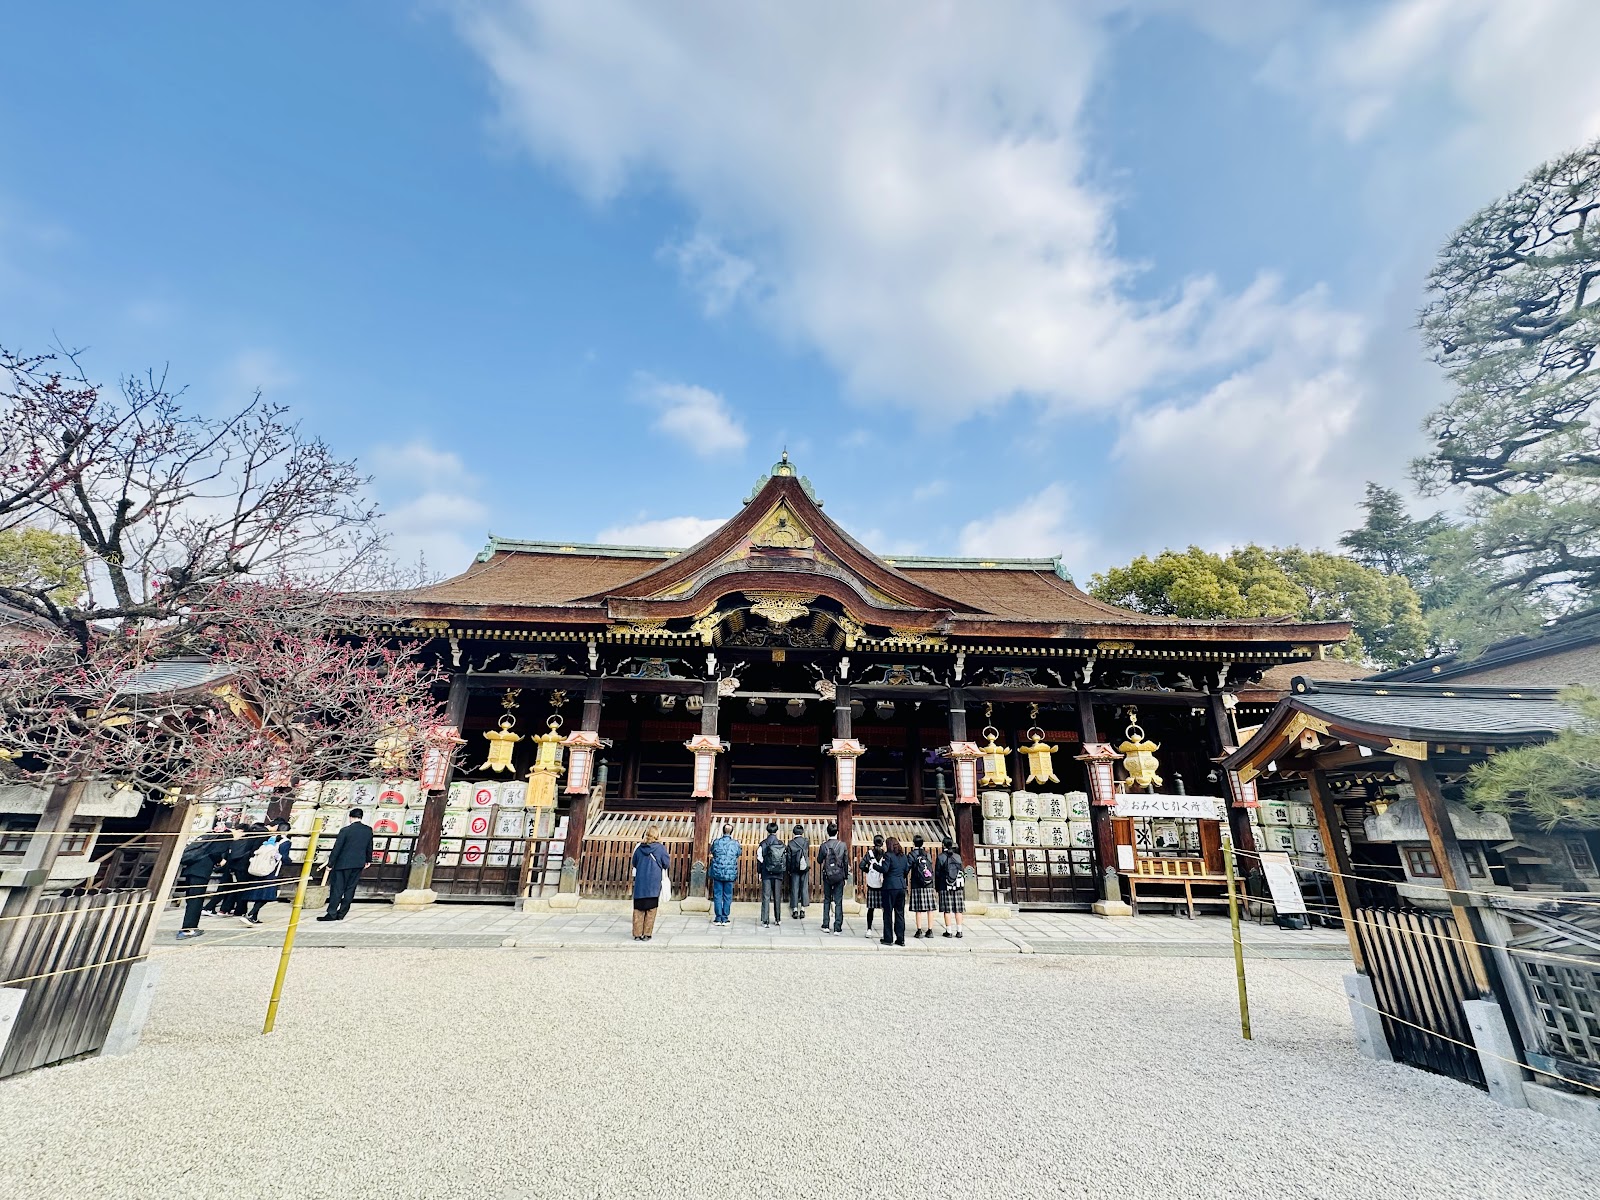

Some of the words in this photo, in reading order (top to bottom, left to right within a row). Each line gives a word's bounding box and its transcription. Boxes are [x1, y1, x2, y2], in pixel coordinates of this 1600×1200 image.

[1131, 801, 1201, 812] おみくじ引く所
